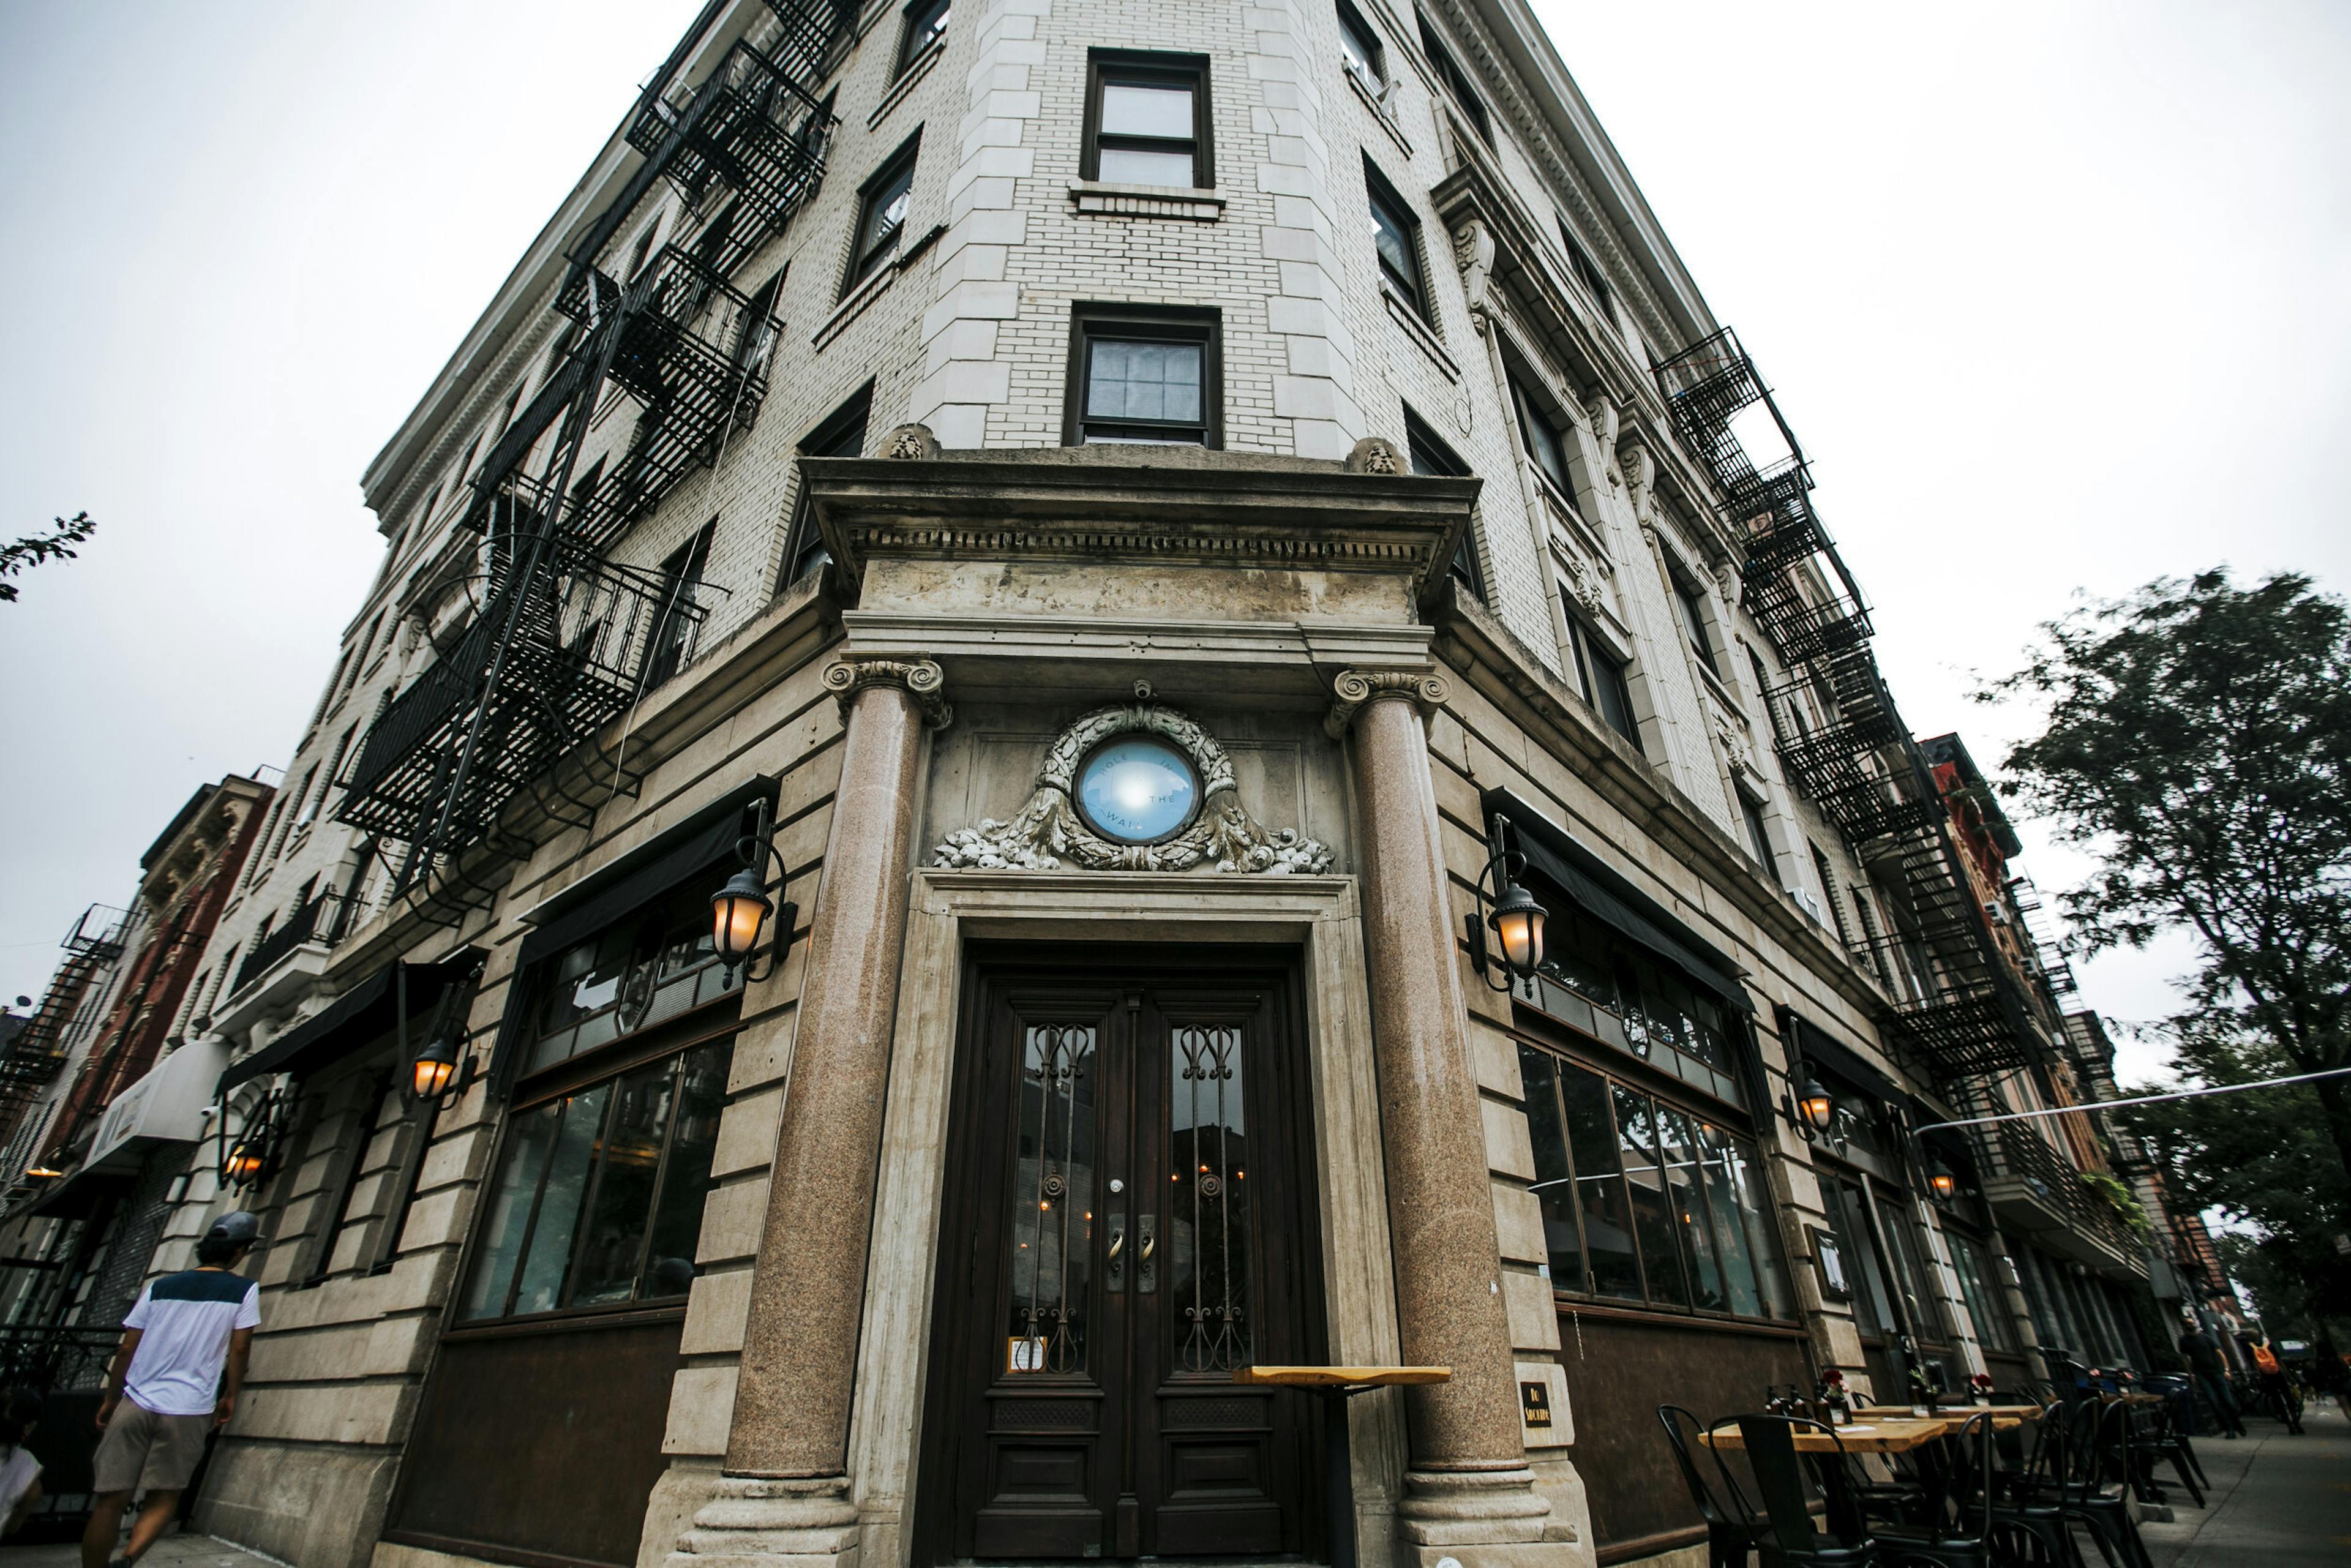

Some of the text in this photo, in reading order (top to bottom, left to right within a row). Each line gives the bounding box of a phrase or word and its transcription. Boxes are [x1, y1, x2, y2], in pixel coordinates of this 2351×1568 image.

[1100, 753, 1127, 775] HOLE
[1160, 760, 1172, 770] IN
[1107, 811, 1142, 829] WALL
